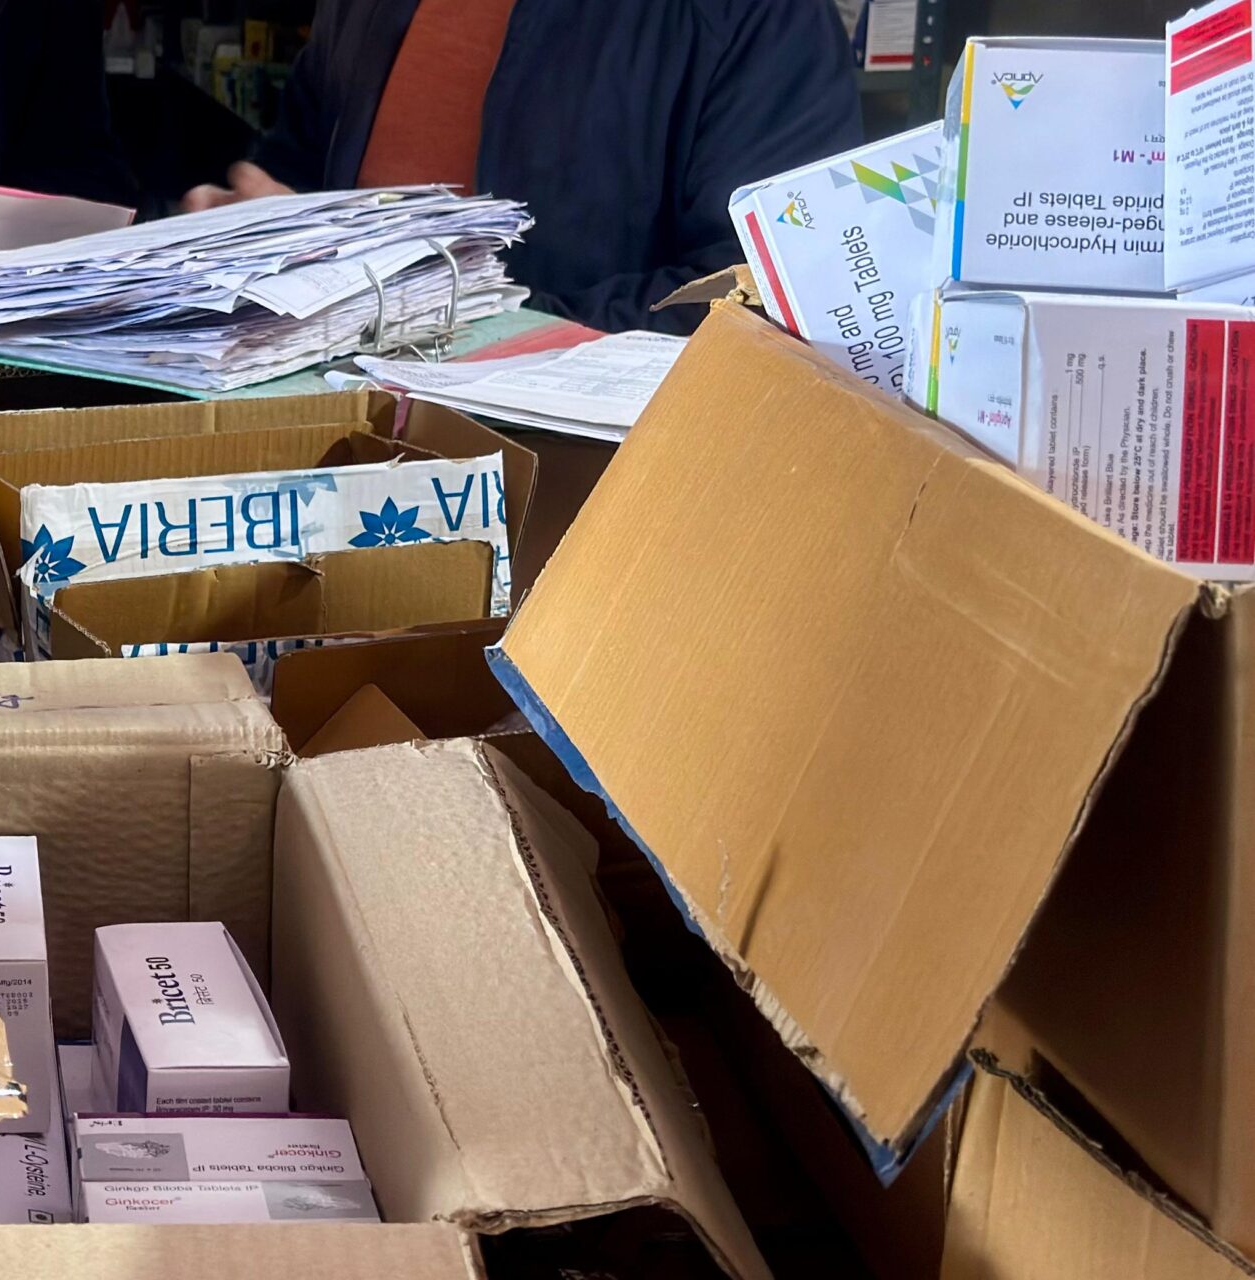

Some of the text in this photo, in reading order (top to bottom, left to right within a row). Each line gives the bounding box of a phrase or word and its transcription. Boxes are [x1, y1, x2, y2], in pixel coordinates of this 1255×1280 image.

[1113, 149, 1135, 164] M1
[1013, 192, 1033, 208] IP
[1039, 192, 1106, 211] Tablets
[1003, 212, 1038, 228] and
[986, 233, 1116, 255] Hydrochloride
[841, 225, 881, 293] Tablets
[867, 291, 894, 322] mg
[826, 304, 862, 340] and
[874, 325, 905, 360] 100
[847, 339, 875, 373] mg
[1066, 353, 1076, 367] mg
[1077, 353, 1087, 367] mg
[1137, 377, 1146, 397] dark
[1136, 399, 1145, 416] and
[1136, 418, 1146, 433] dry
[1132, 469, 1141, 495] below
[88, 489, 300, 563] IBERIA
[145, 956, 196, 1026] Bricet 50
[18, 1144, 50, 1197] L-Cysteine,
[208, 1163, 255, 1173] Tablets
[258, 1164, 296, 1173] Biloba
[299, 1164, 345, 1173] Ginkgo
[104, 1185, 150, 1193] Ginkgo
